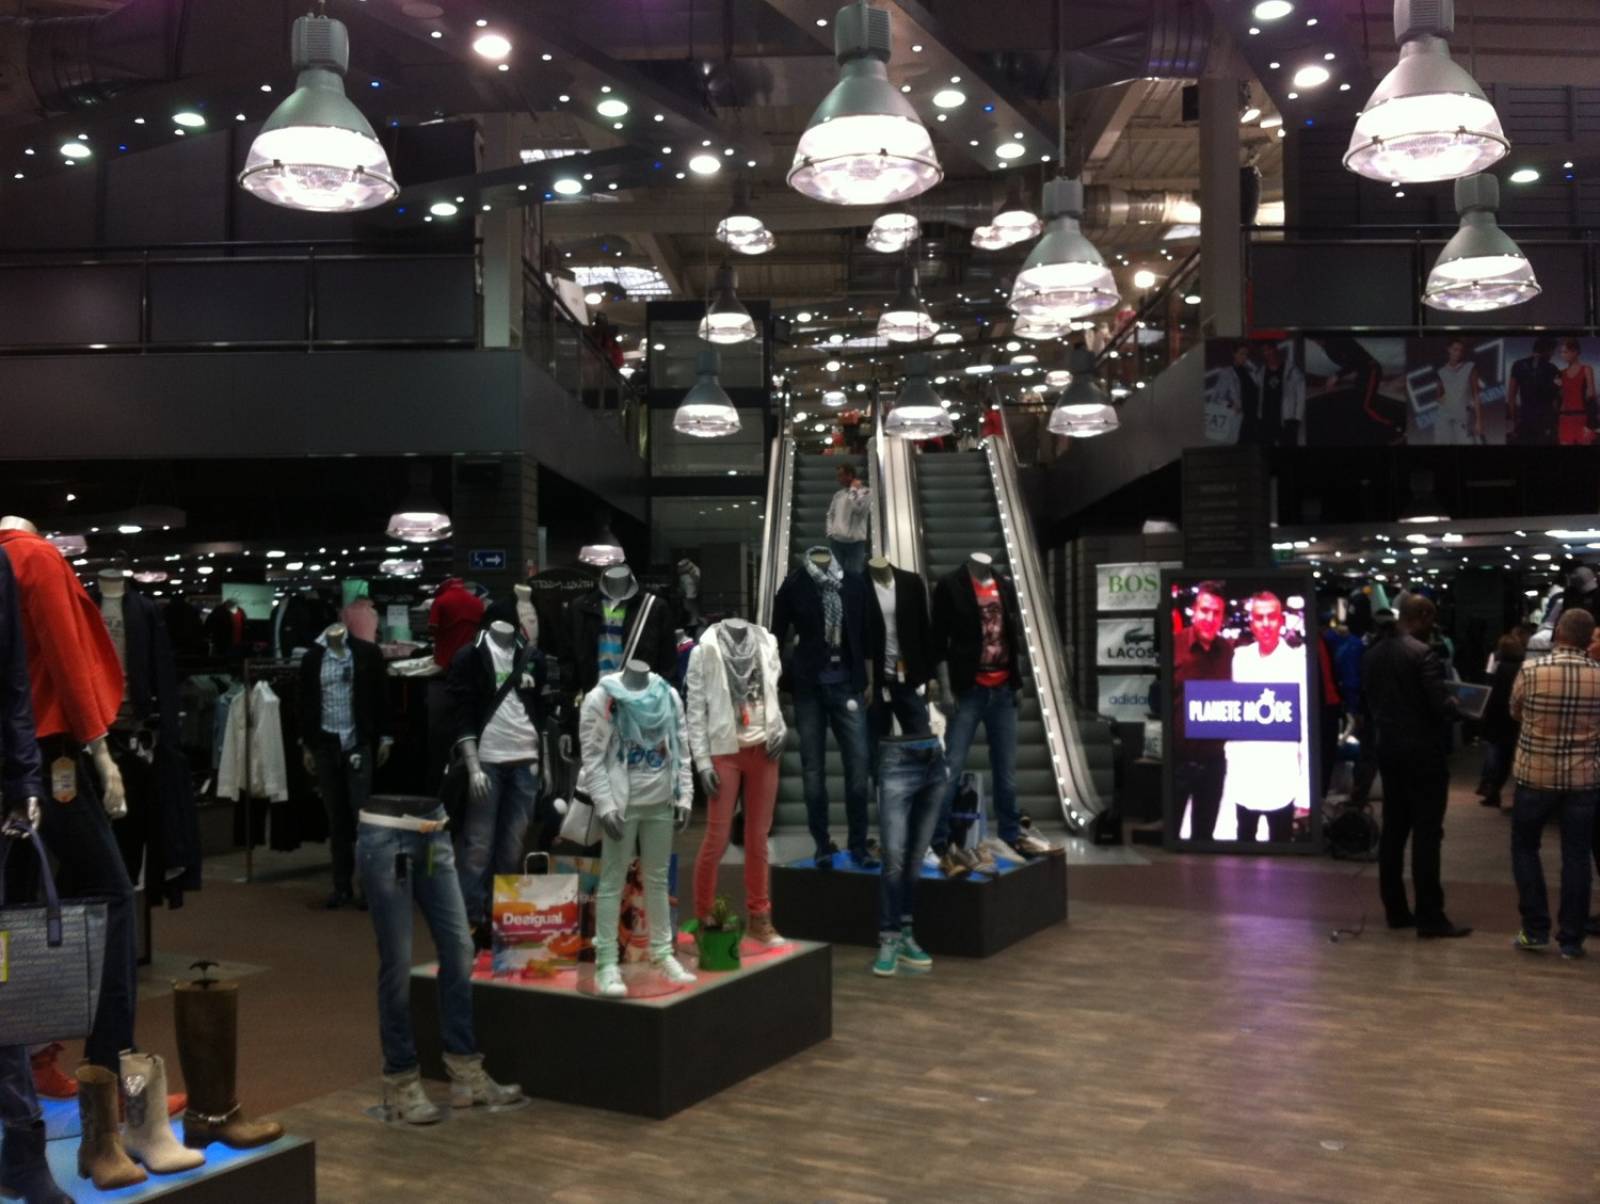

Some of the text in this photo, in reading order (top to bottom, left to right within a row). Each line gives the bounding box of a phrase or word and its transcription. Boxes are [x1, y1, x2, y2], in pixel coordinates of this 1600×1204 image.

[1108, 575, 1158, 593] BOS
[1107, 647, 1154, 659] LACOS
[1108, 693, 1148, 705] adida
[502, 911, 564, 927] Desigual
